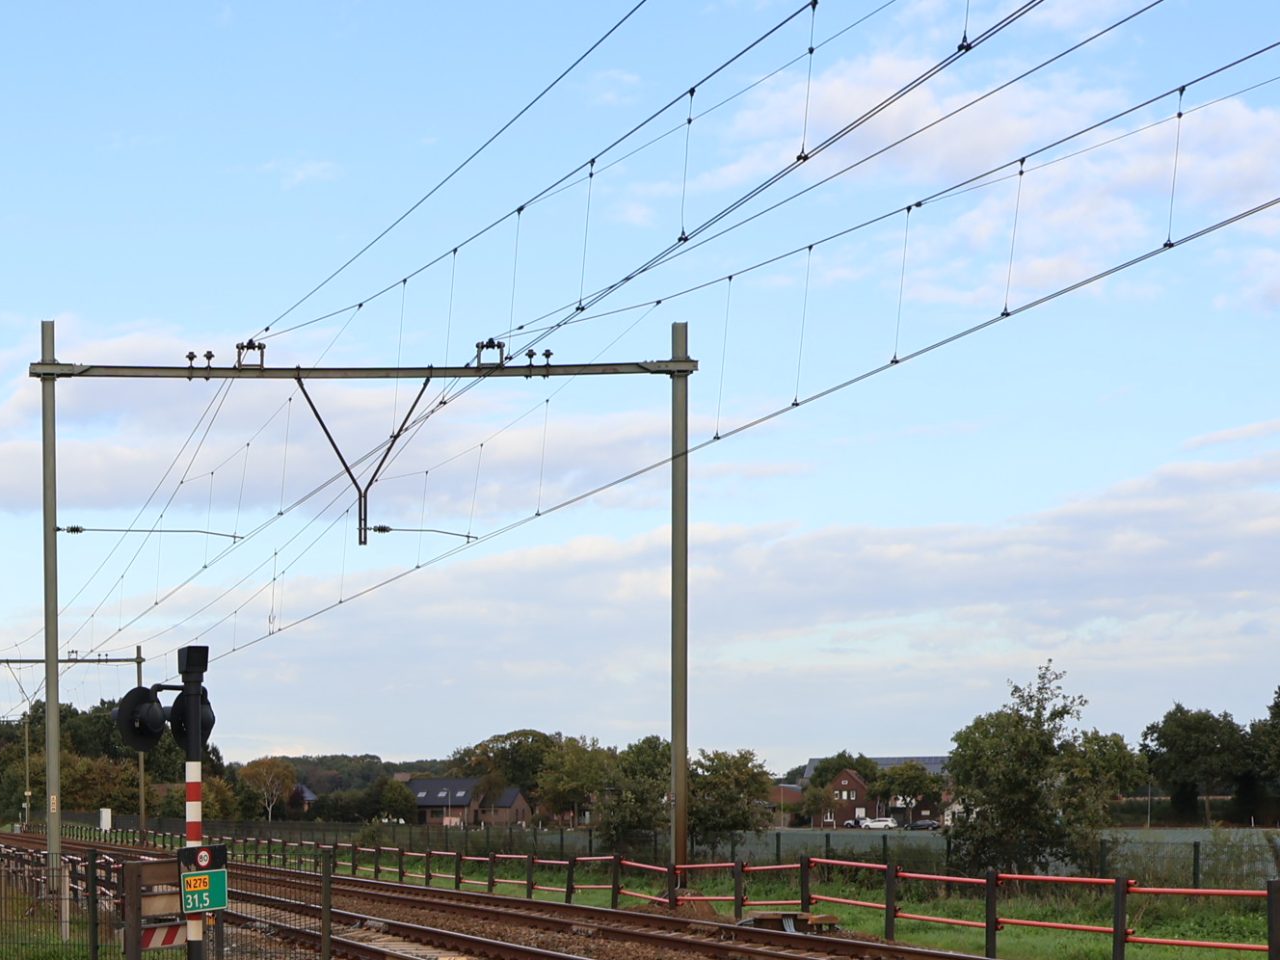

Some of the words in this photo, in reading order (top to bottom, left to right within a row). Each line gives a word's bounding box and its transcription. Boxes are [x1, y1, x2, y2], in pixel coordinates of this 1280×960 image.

[199, 854, 209, 862] 80
[186, 878, 208, 889] N276
[186, 893, 210, 909] 31,5
